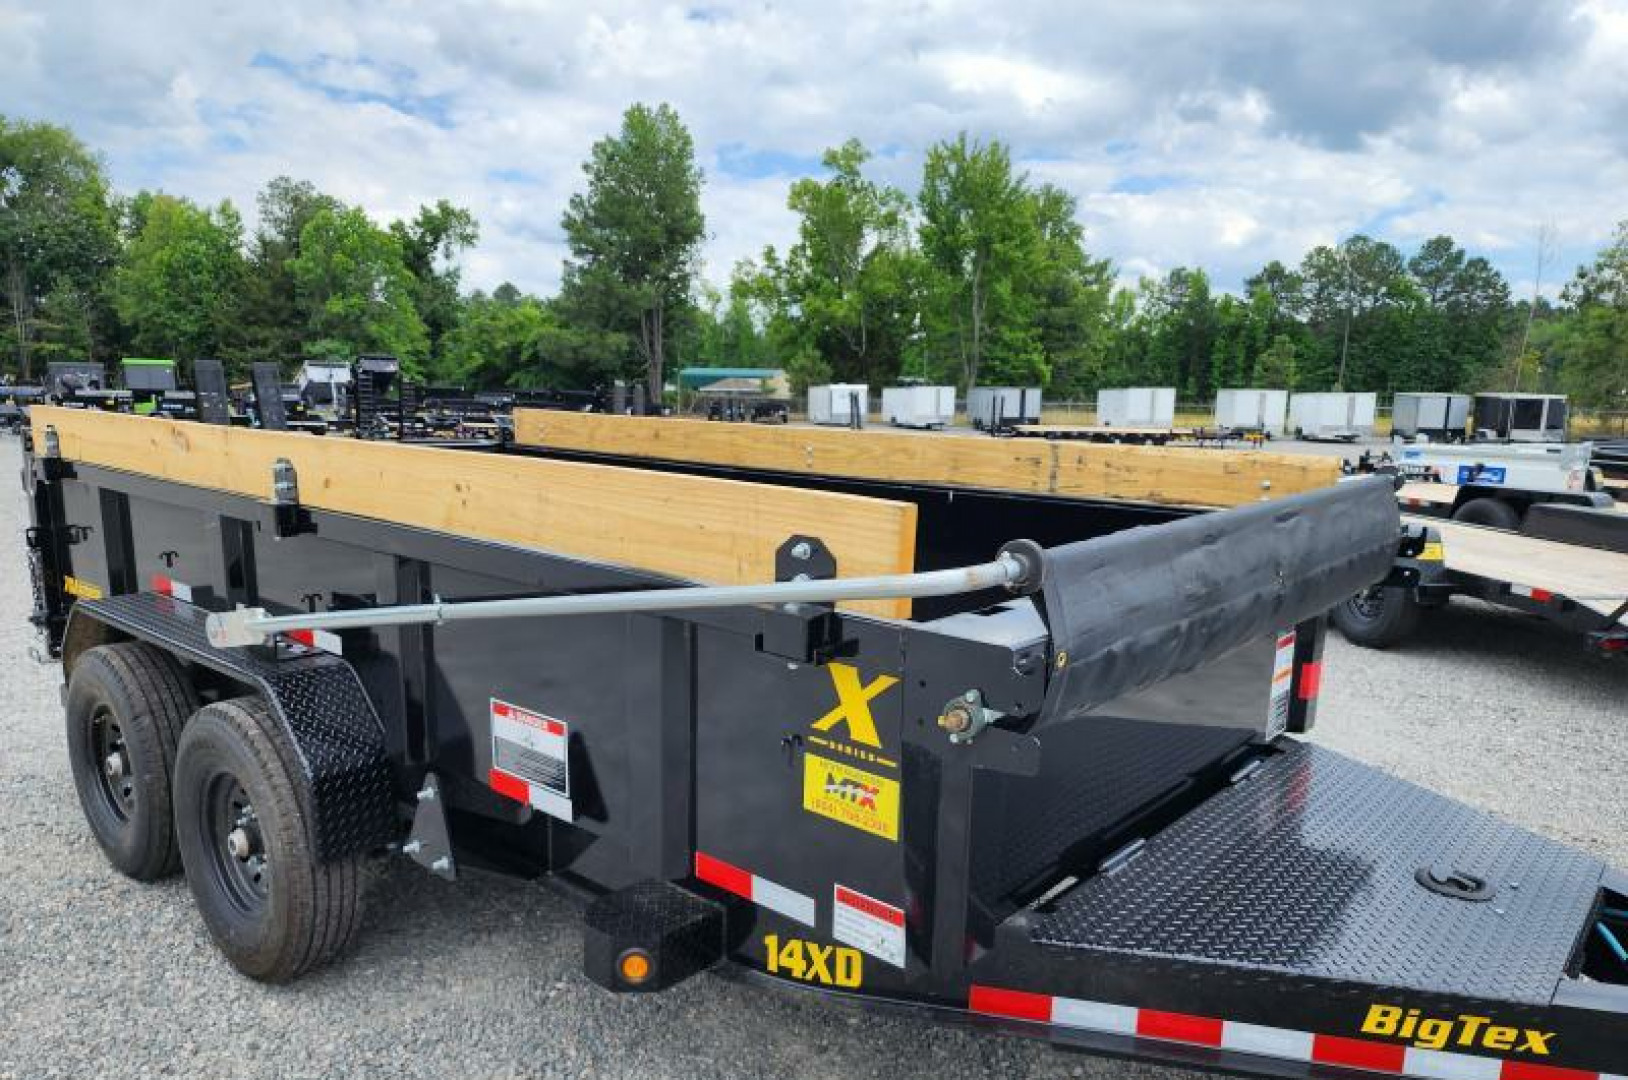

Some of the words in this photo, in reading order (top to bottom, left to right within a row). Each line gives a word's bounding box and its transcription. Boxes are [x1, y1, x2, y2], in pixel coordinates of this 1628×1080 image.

[810, 662, 902, 749] X
[763, 933, 863, 988] 14XD
[1360, 1003, 1558, 1055] BigTex
